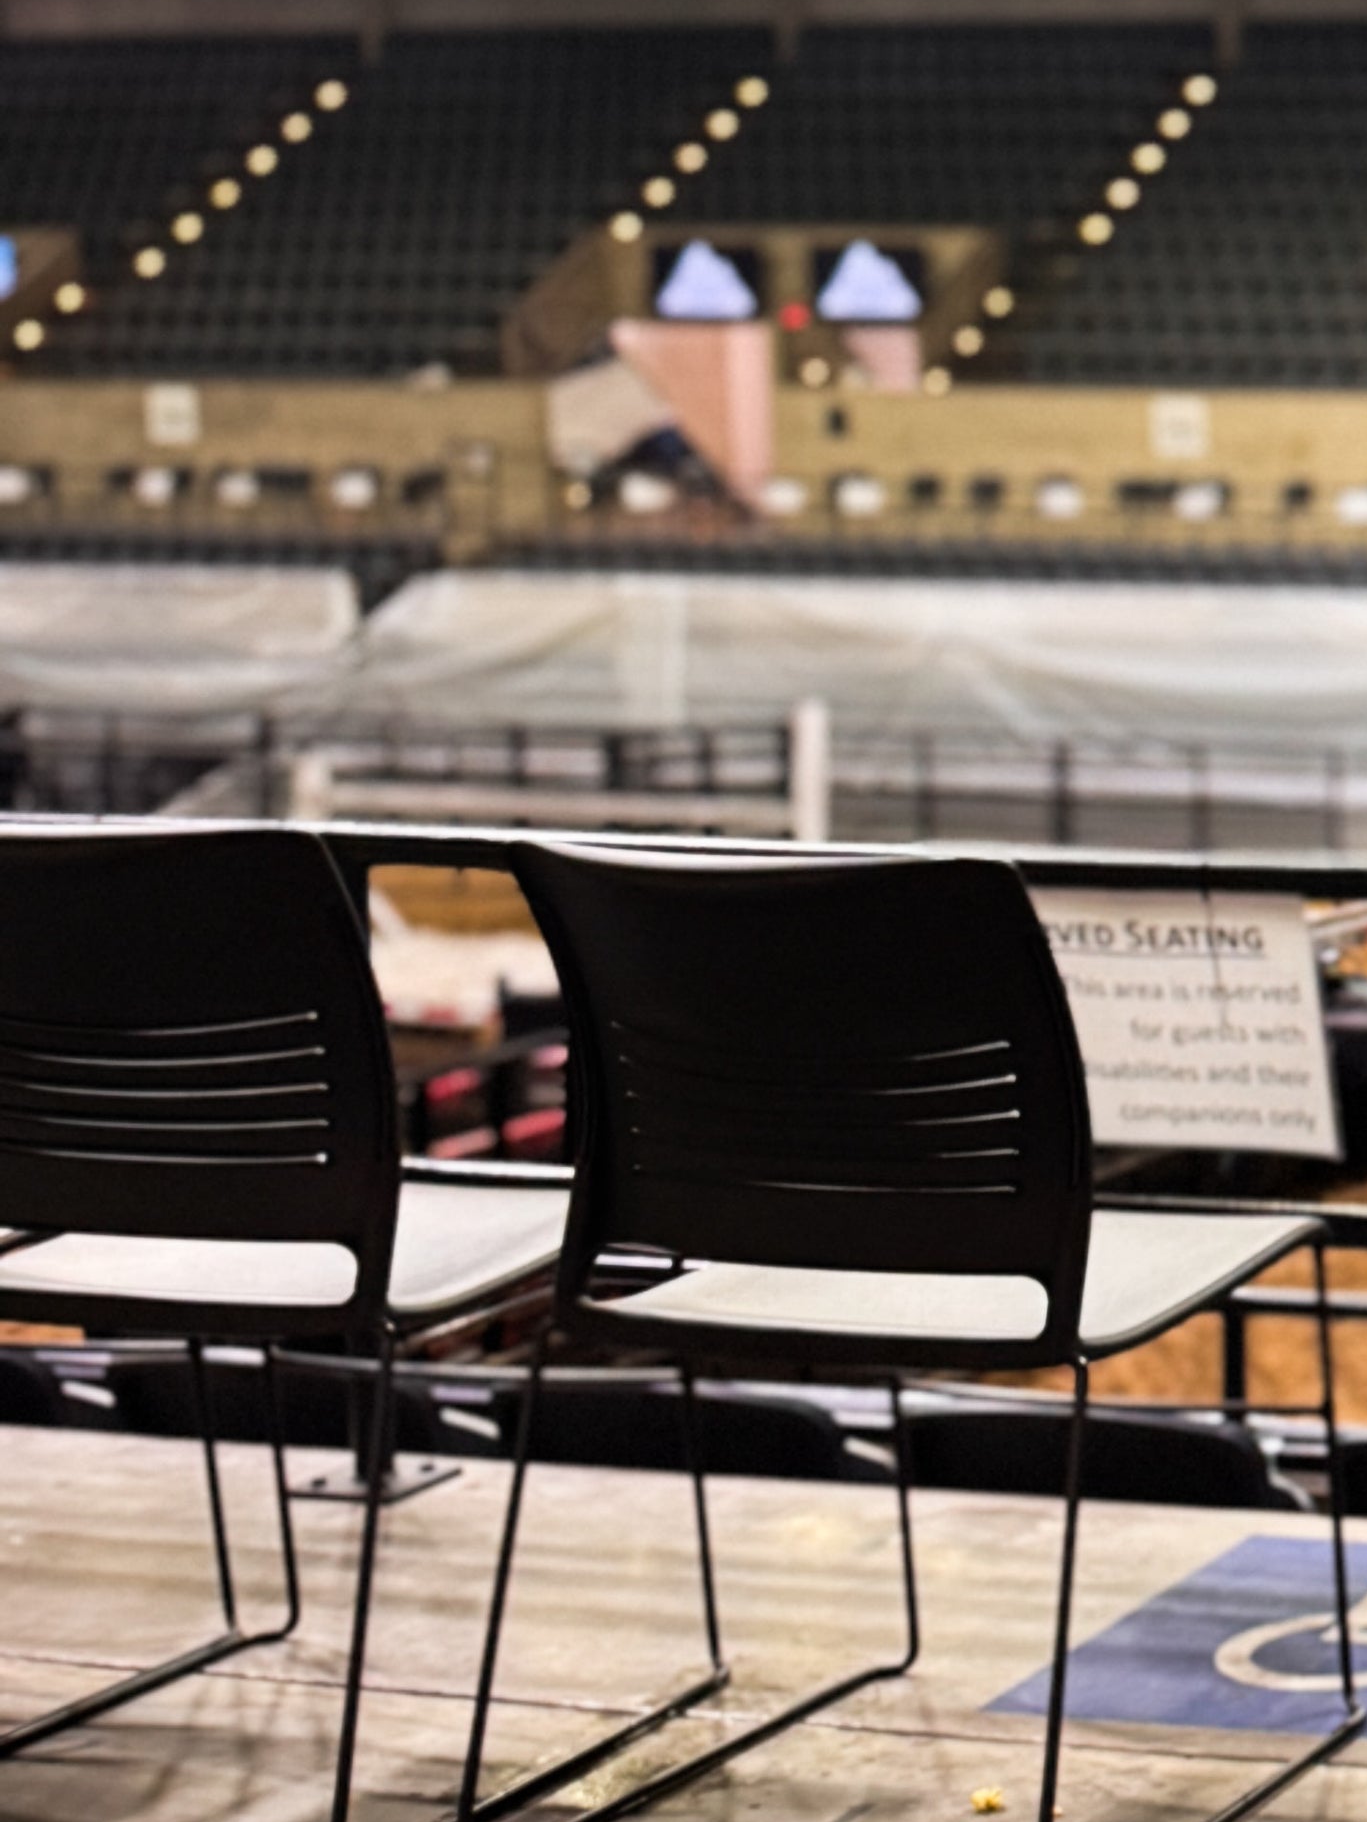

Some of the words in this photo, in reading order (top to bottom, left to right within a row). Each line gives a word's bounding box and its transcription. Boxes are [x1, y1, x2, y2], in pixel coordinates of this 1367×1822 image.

[1048, 923, 1114, 947] VED
[1123, 919, 1264, 951] SEATING
[1114, 982, 1164, 999] area
[1171, 979, 1191, 1000] is
[1200, 981, 1302, 1004] reserved
[1130, 1018, 1162, 1040] for
[1172, 1022, 1250, 1047] guests
[1257, 1023, 1308, 1045] with
[1085, 1059, 1199, 1083] isabilities
[1209, 1063, 1250, 1085] and
[1257, 1063, 1311, 1087] their
[1120, 1104, 1263, 1129] companions
[1269, 1107, 1316, 1135] only
